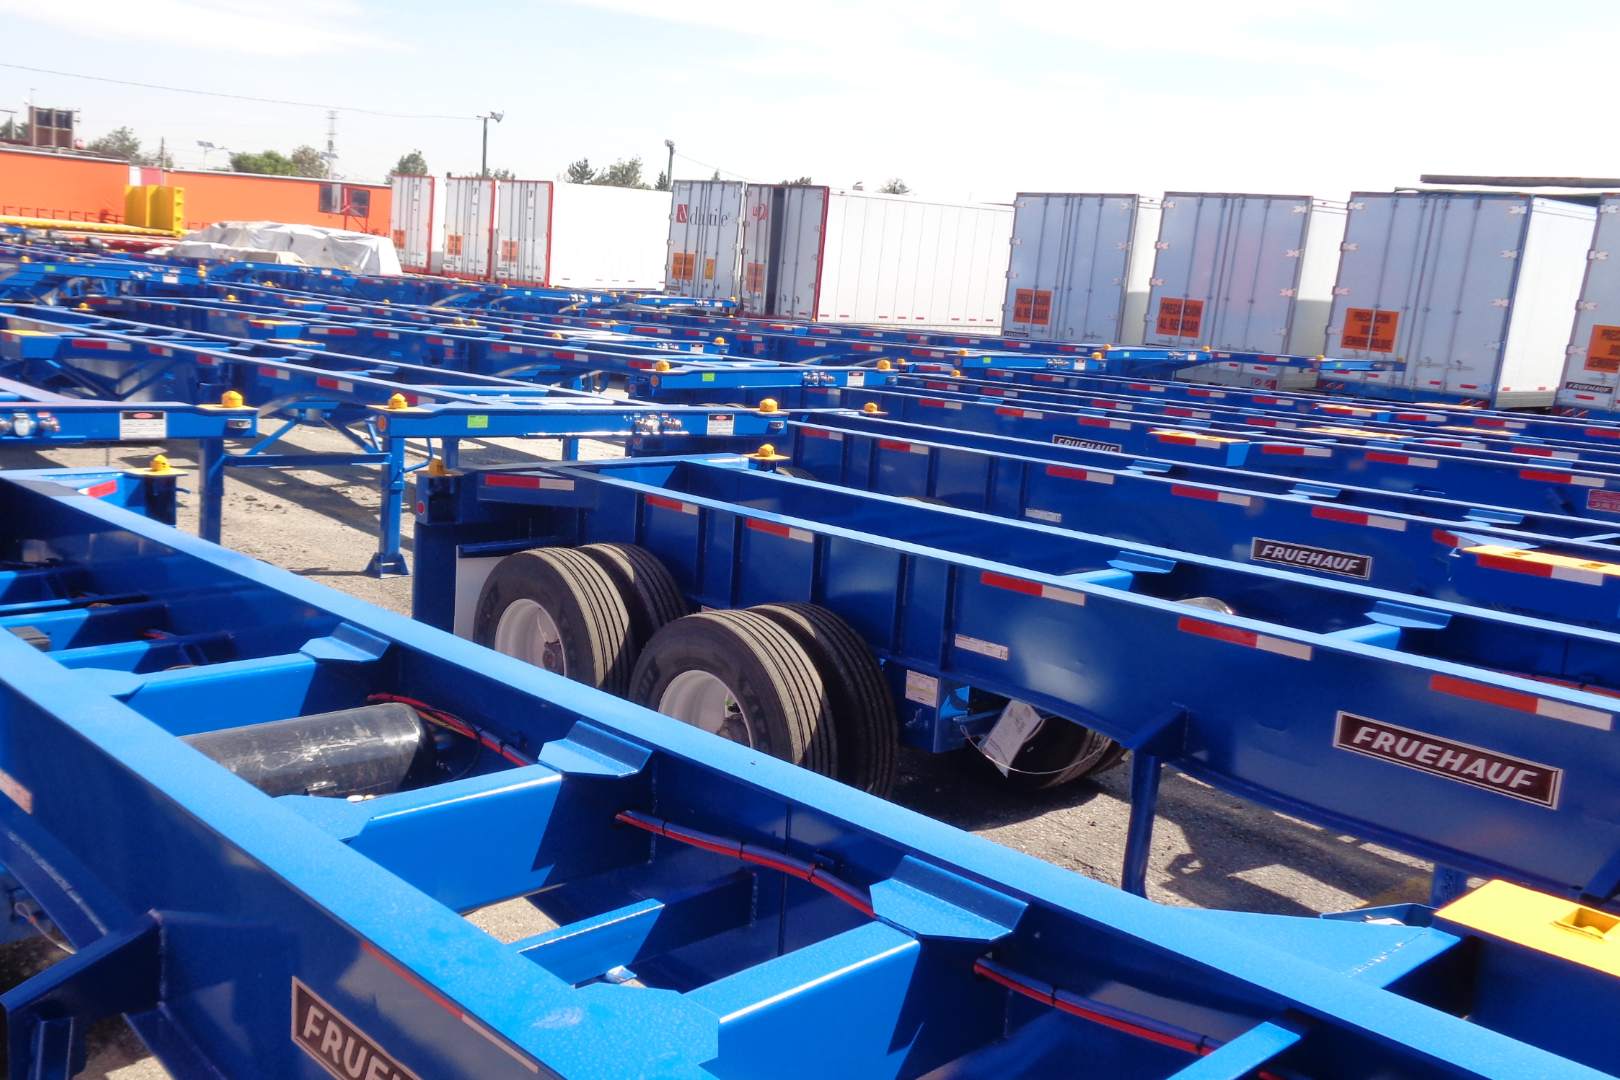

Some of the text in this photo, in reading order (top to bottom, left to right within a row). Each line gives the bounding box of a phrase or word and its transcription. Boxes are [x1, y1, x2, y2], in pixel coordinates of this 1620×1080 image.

[1261, 544, 1360, 571] FRUEHAUF
[1353, 726, 1538, 788] FRUEHAUF
[303, 1005, 401, 1080] FRUE
